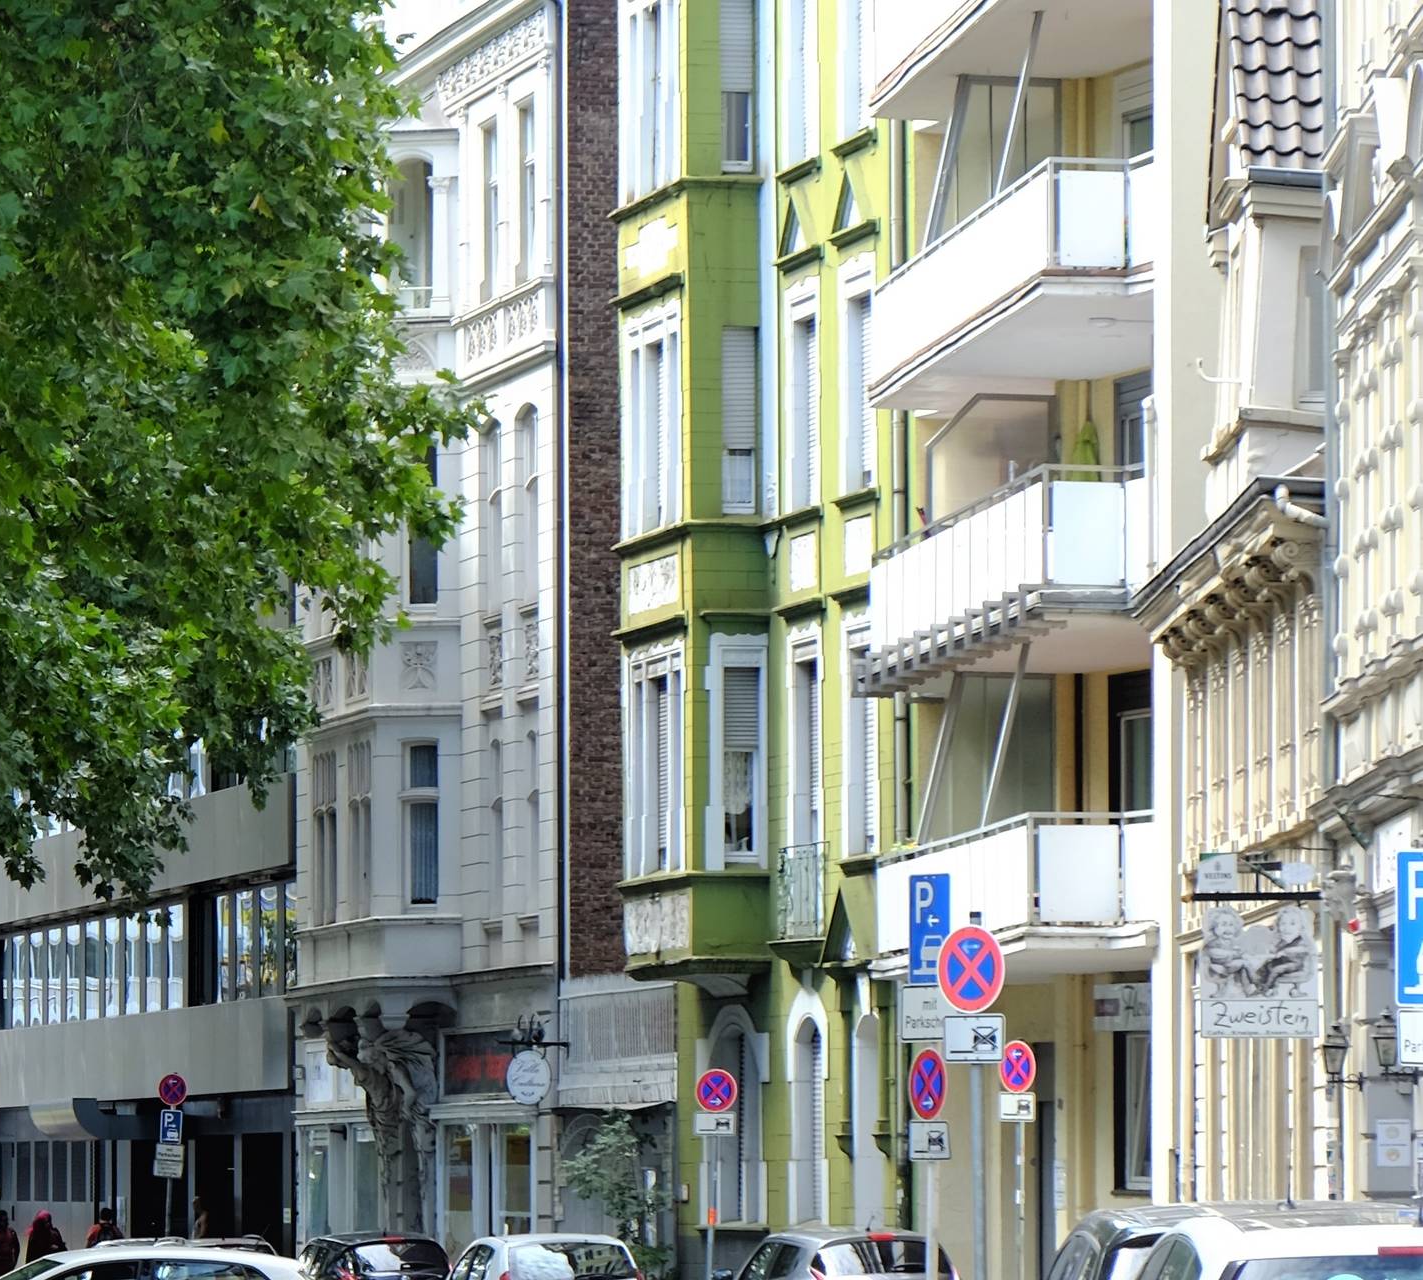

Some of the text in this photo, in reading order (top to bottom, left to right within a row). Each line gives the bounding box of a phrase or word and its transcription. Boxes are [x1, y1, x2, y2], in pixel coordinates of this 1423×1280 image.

[915, 881, 934, 924] P
[922, 1000, 938, 1010] mit
[1211, 1000, 1309, 1031] Zweistein
[164, 1113, 174, 1128] P
